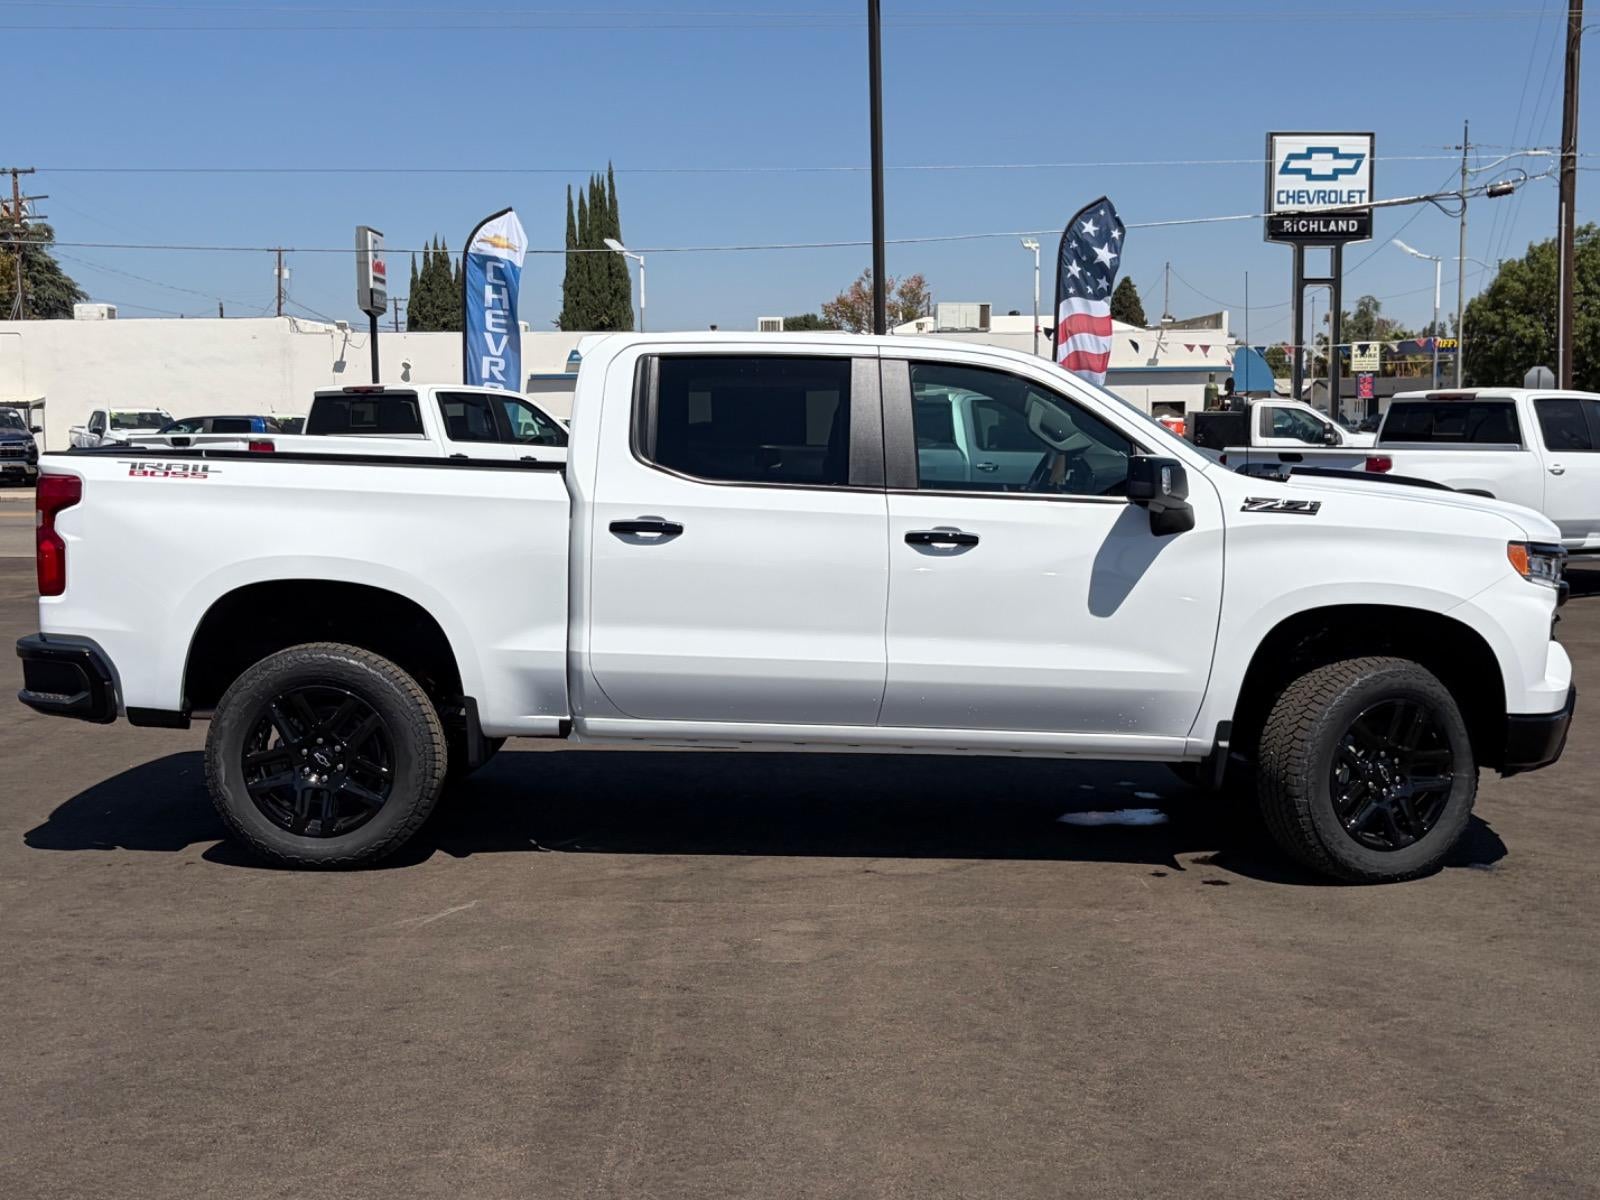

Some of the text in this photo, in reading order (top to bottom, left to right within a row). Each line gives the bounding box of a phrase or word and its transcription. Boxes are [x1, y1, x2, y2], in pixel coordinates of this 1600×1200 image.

[1276, 190, 1366, 205] CHEVROLET
[1283, 220, 1359, 232] RICHLAND
[118, 461, 222, 473] TRAIL
[129, 470, 208, 479] BOSS
[1240, 497, 1322, 516] Z71
